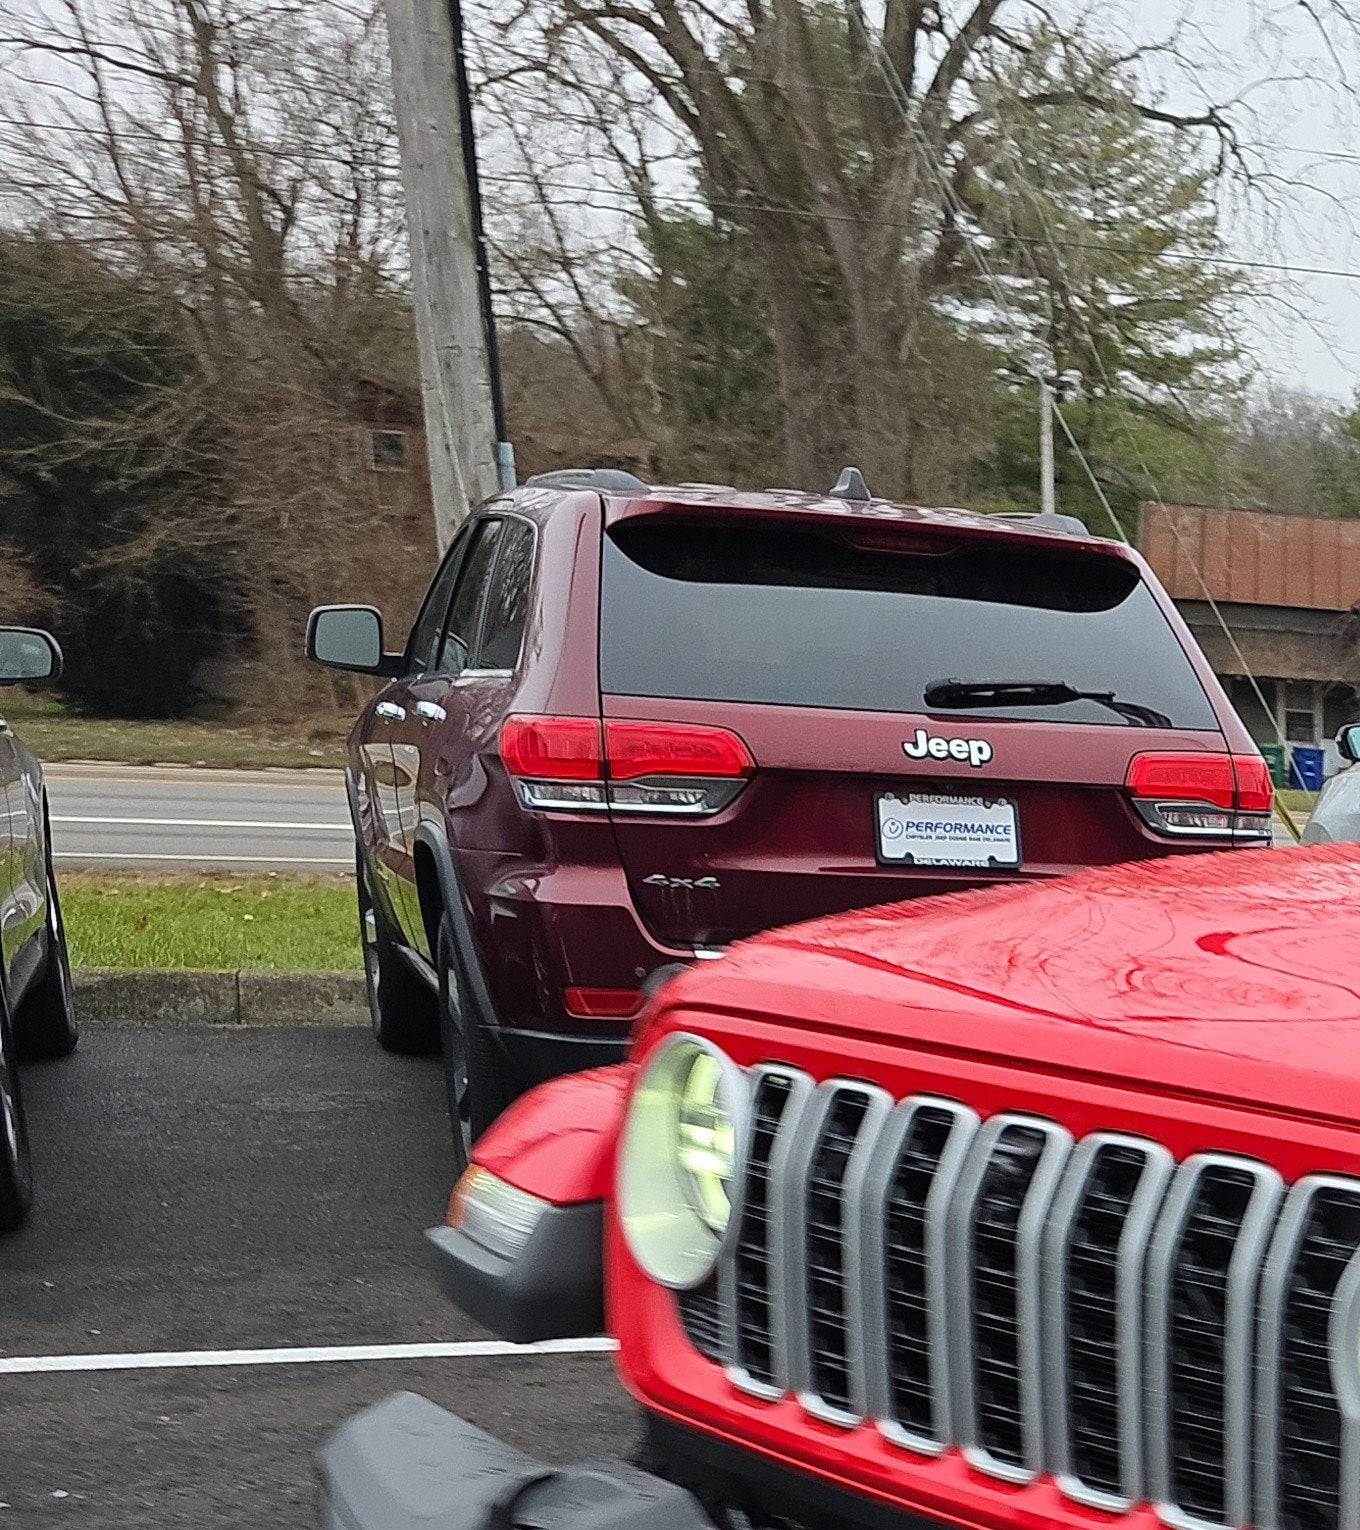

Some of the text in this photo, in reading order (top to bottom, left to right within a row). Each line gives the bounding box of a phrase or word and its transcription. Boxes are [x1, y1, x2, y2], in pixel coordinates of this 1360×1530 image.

[902, 728, 993, 767] Jeep
[908, 793, 984, 806] PERFORMANCE
[905, 820, 1012, 835] PERFORMANCE
[913, 857, 990, 867] DELAWARE
